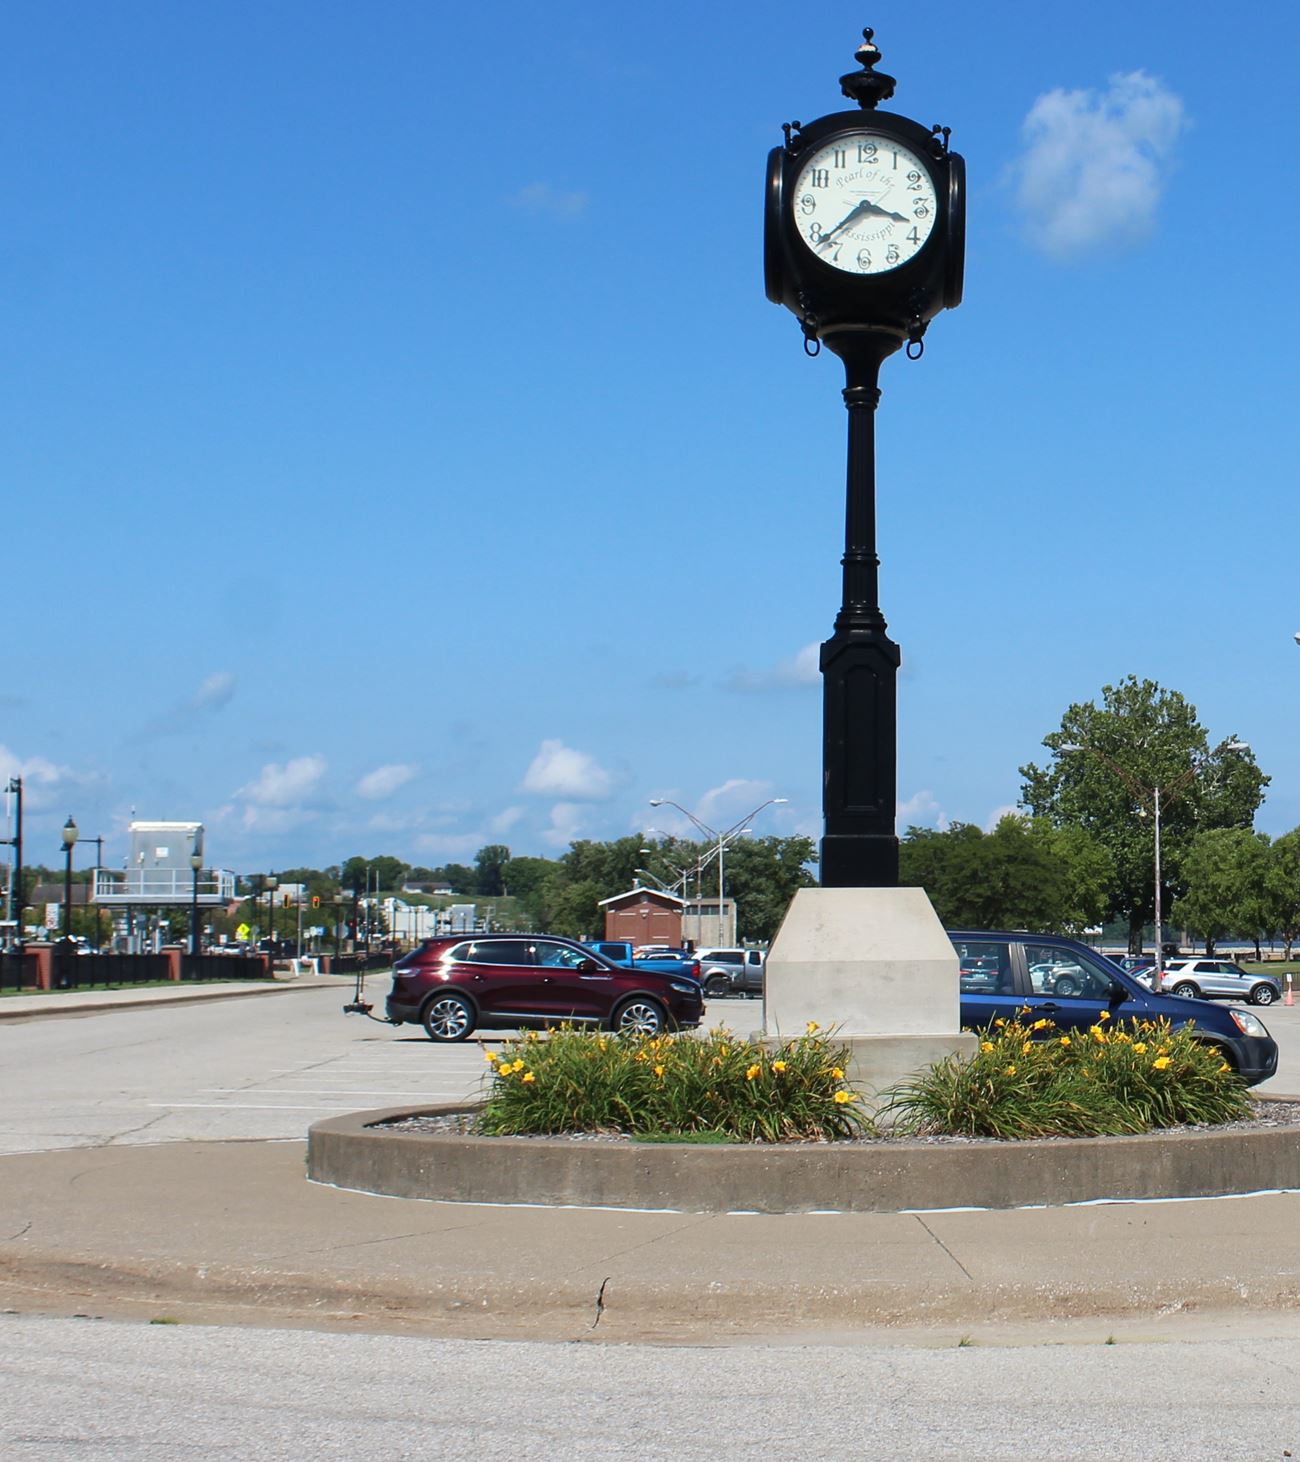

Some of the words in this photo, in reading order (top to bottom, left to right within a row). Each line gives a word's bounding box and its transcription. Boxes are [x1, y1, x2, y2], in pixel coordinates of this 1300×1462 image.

[834, 150, 846, 169] 11
[857, 143, 879, 164] 12
[892, 151, 898, 170] 1
[812, 168, 829, 189] 10
[835, 166, 863, 188] Pearl
[865, 169, 880, 182] of
[880, 175, 895, 187] the
[906, 170, 922, 191] 2
[801, 193, 817, 216] 9
[913, 197, 930, 219] 3
[810, 222, 823, 243] 8
[842, 220, 896, 242] ississippi
[906, 226, 921, 245] 4
[828, 241, 844, 262] 7
[857, 248, 872, 270] 6
[886, 244, 900, 264] 5
